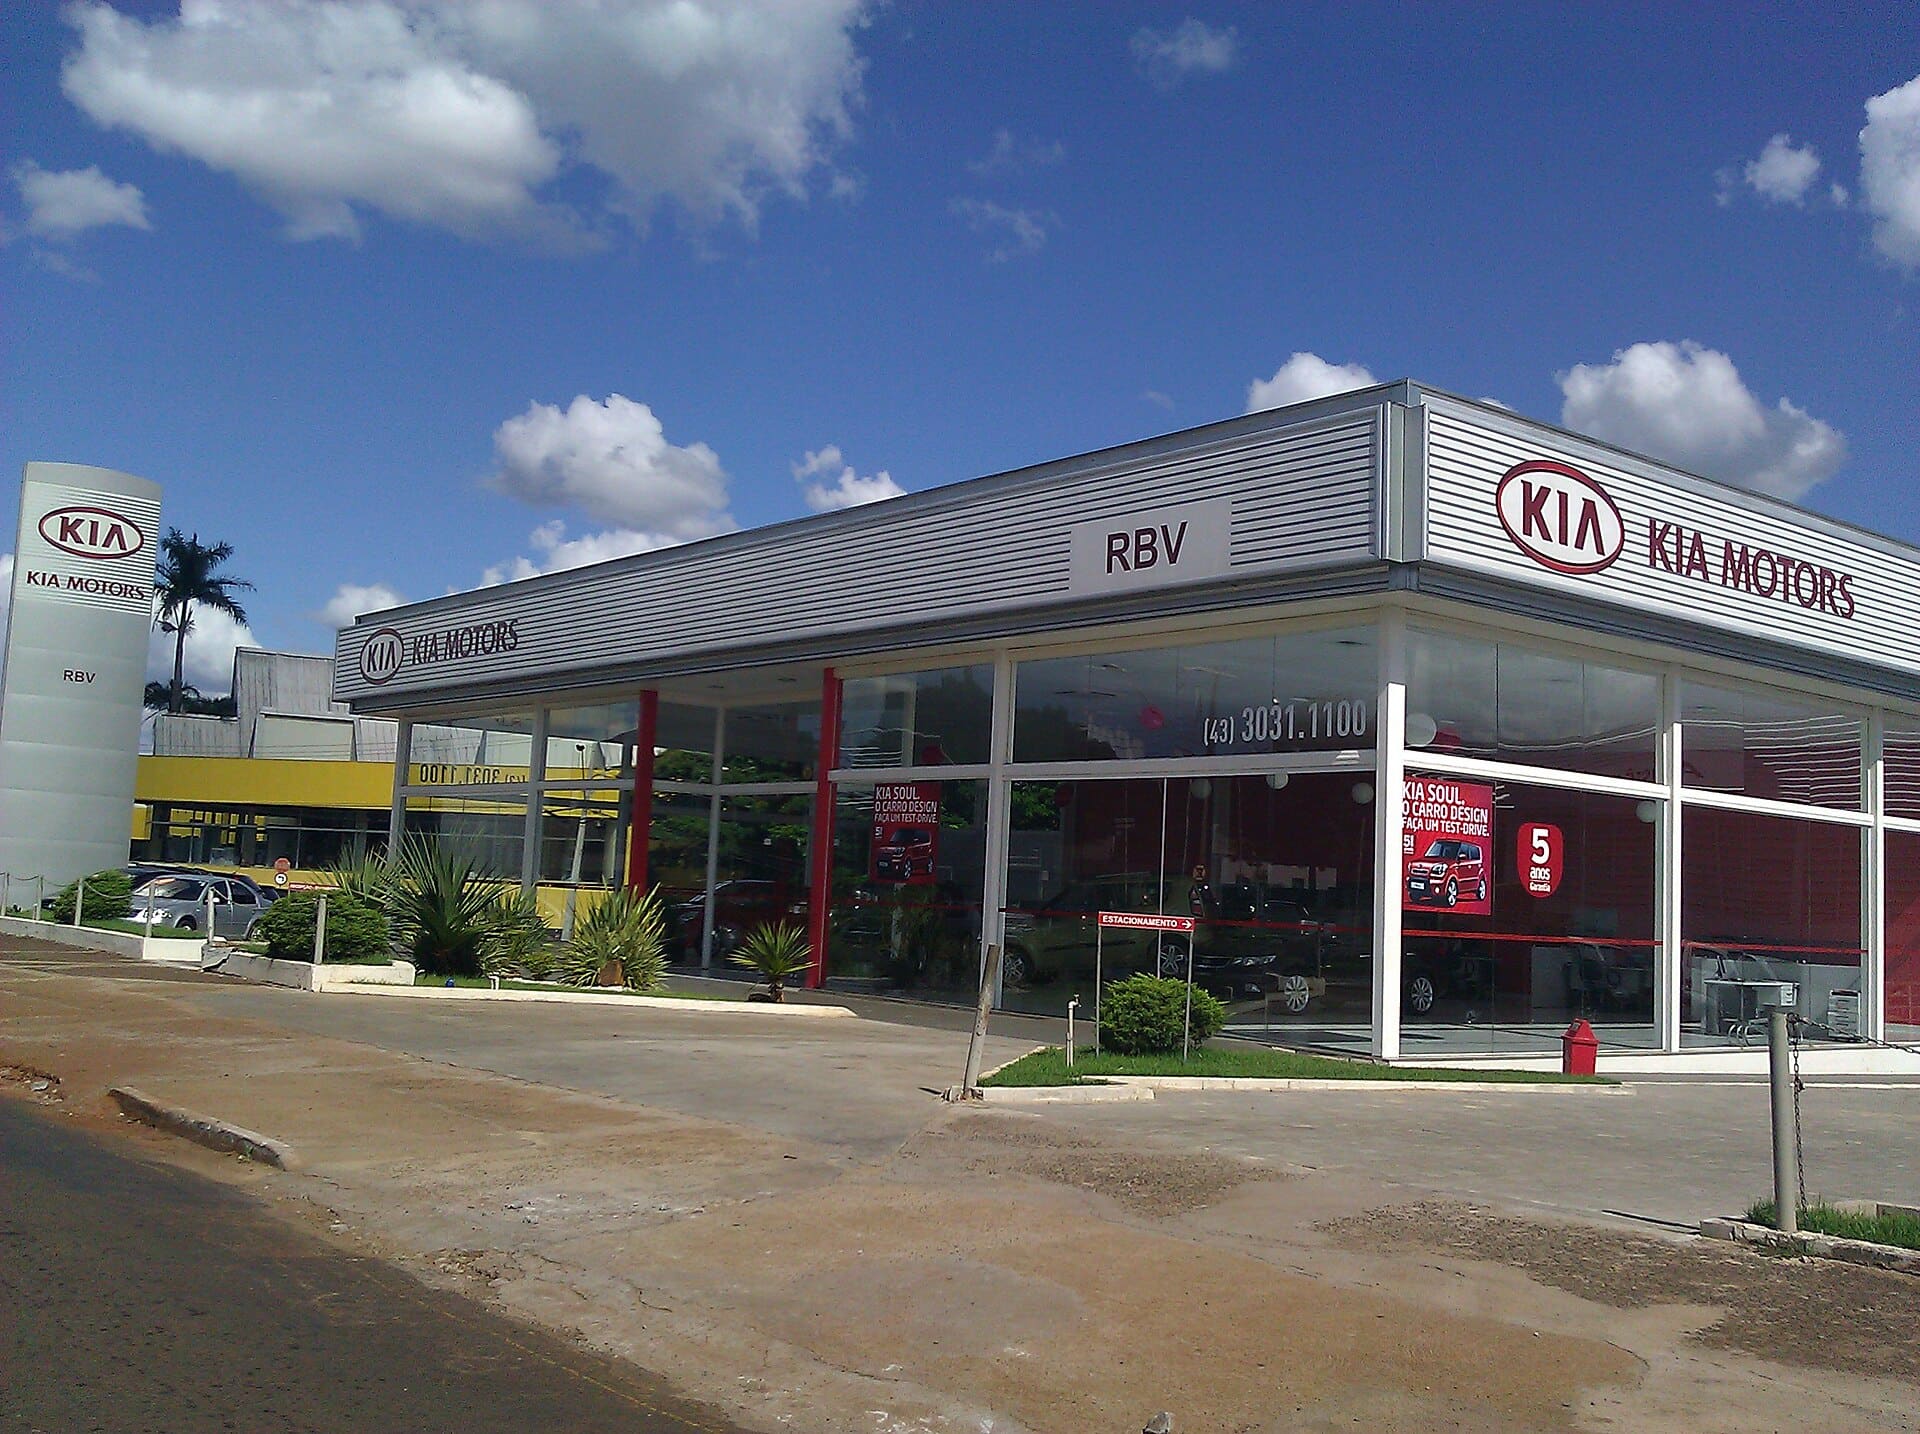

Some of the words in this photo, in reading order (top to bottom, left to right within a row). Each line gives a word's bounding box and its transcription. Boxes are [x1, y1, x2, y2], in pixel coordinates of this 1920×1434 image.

[1520, 479, 1606, 557] KIA
[59, 516, 127, 551] KIA
[1105, 520, 1188, 575] RBV
[1648, 517, 1710, 584] KIA
[1721, 539, 1856, 619] MOTORS
[26, 570, 60, 588] KIA
[66, 575, 146, 600] MOTORS
[366, 640, 397, 673] KIA
[411, 633, 439, 665] KIA
[444, 619, 519, 661] MOTORS
[63, 669, 96, 683] RBV
[1203, 716, 1235, 746] (43)
[1241, 700, 1367, 742] 3031.1100
[875, 786, 891, 800] KIA
[893, 786, 920, 800] SOUL.
[875, 801, 881, 812] O
[882, 801, 907, 812] CARRO
[908, 801, 938, 813] DESIGN
[1402, 781, 1425, 800] KIA
[1427, 783, 1465, 805] SOUL.
[1401, 816, 1424, 832] FAÇA
[1425, 818, 1439, 832] UM
[1440, 820, 1490, 837] TEST-DRIVE.
[1402, 800, 1410, 815] O
[1412, 801, 1448, 819] CARRO
[1450, 805, 1489, 824] DESIGN
[1531, 828, 1550, 864] 5
[1529, 866, 1551, 880] anos
[1102, 914, 1178, 928] ESTACIONAMENTO
